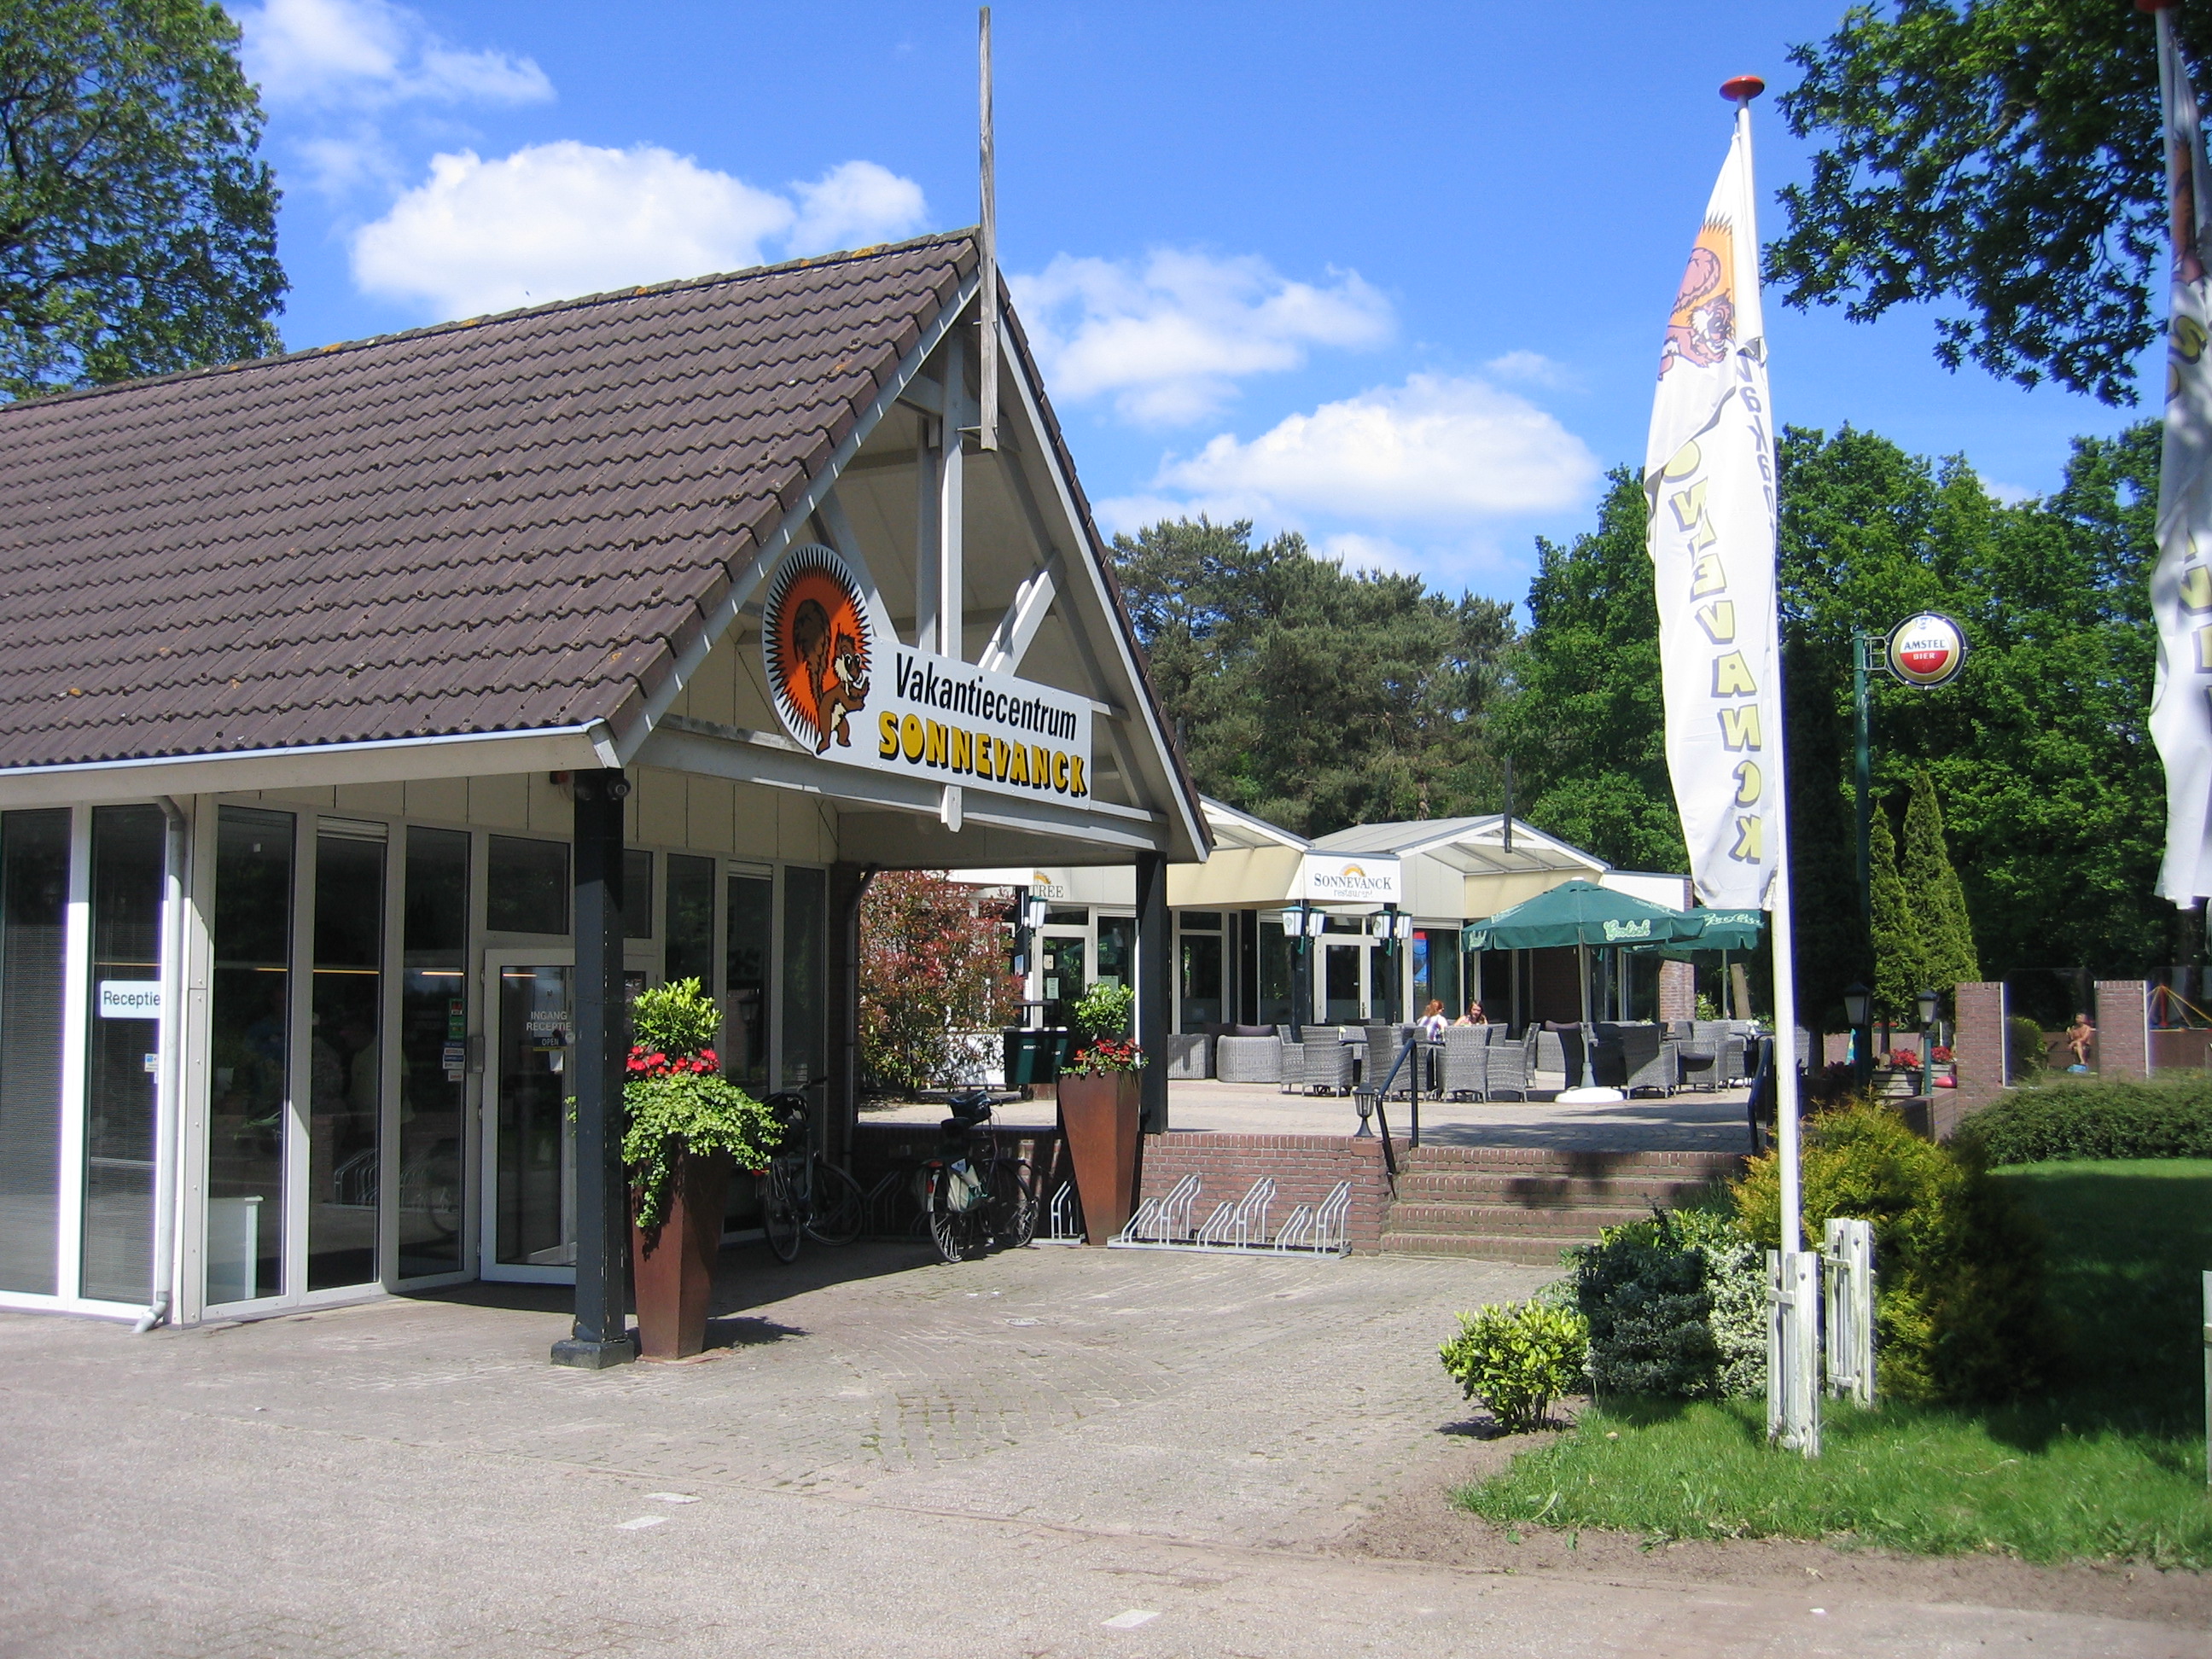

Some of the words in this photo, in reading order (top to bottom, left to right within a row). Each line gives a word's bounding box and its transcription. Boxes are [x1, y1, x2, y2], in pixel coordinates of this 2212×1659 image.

[1904, 639, 1945, 650] AMSTEL
[1912, 652, 1936, 661] BIER
[896, 652, 1077, 741] Vakantiecentrum
[878, 711, 1087, 797] SONNEVANCK
[1314, 873, 1393, 890] SONNEVANCK
[103, 990, 161, 1010] Receptie
[530, 1010, 568, 1021] INGANG
[526, 1022, 572, 1032] RECEPTIE
[541, 1038, 559, 1046] OPEN
